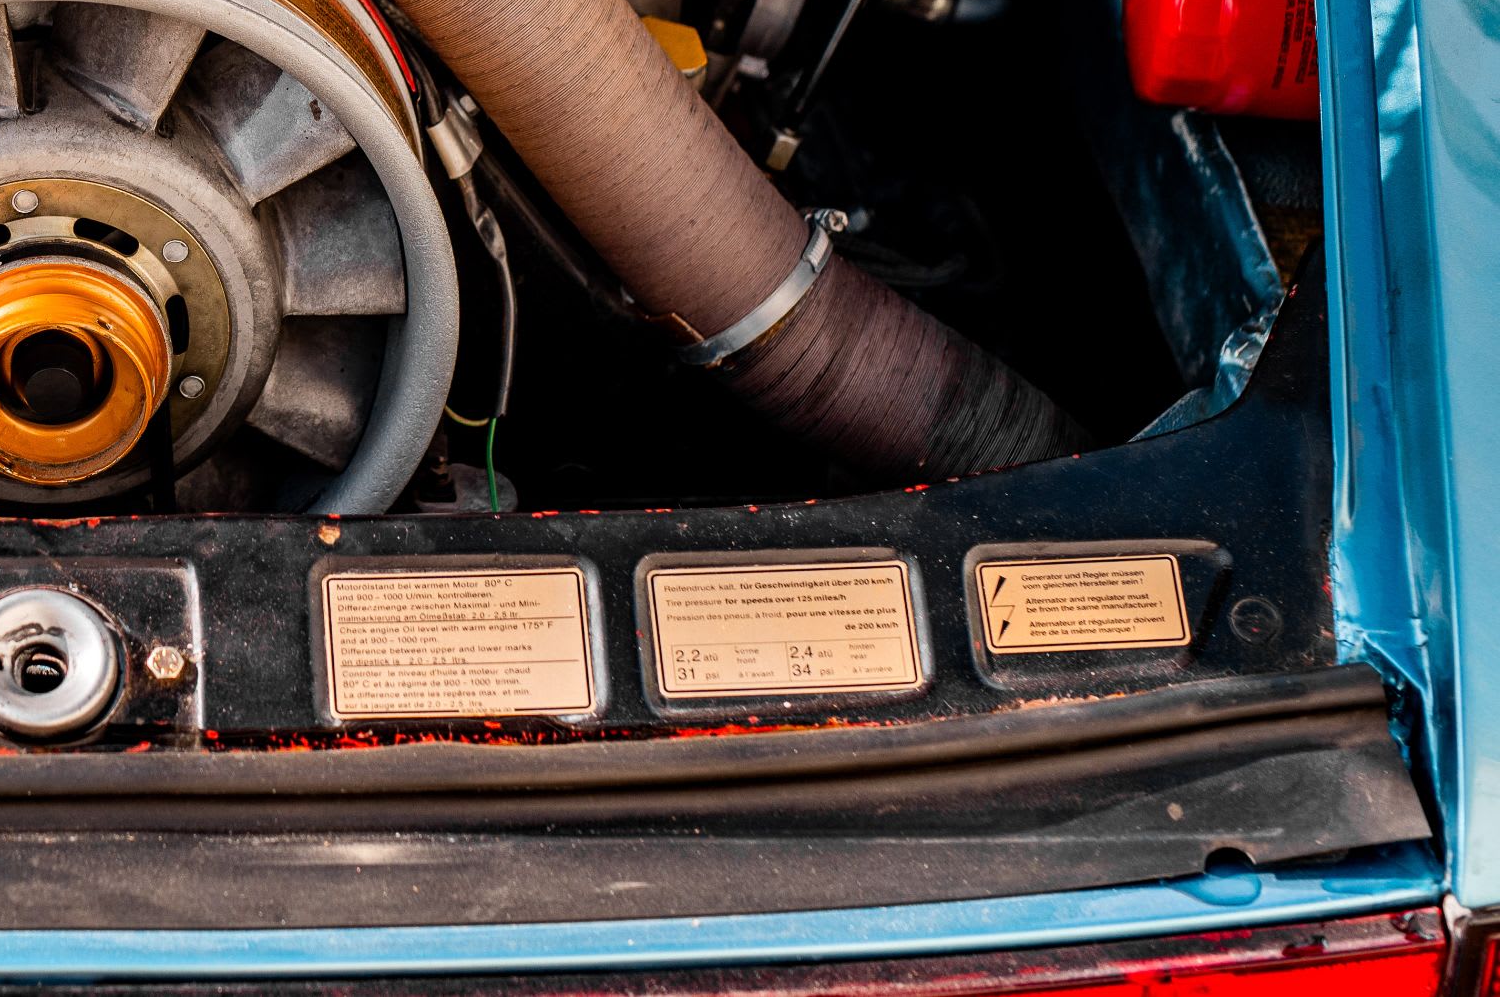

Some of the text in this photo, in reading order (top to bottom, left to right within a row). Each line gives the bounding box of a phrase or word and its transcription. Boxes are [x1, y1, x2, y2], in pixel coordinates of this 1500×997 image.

[1020, 573, 1062, 581] Generator
[1082, 570, 1108, 579] Regler
[1110, 569, 1145, 577] müssen
[452, 580, 477, 588] Motor
[504, 578, 512, 586] C
[663, 583, 715, 592] Reifendruck
[754, 579, 830, 590] Geschwindigkeit
[831, 578, 851, 586] über
[1041, 581, 1078, 590] gleichen
[740, 596, 773, 605] speeds
[1025, 596, 1067, 604] Alternator
[1087, 593, 1125, 603] regulator
[1101, 601, 1157, 609] manufacturer
[666, 613, 704, 621] Pression
[827, 608, 861, 616] vitesse
[875, 606, 897, 614] plus
[339, 626, 366, 634] Check
[488, 623, 518, 632] engine
[547, 620, 553, 628] F
[858, 622, 874, 630] 200
[875, 621, 899, 629] km/h
[1029, 619, 1075, 627] Alternateur
[1098, 626, 1131, 634] marque
[340, 646, 386, 655] Difference
[504, 643, 531, 651] marks
[789, 645, 813, 659] 2,4
[674, 649, 701, 663] 2,2
[355, 657, 388, 667] dipstick
[503, 666, 530, 674] chaud
[677, 667, 695, 680] 31
[791, 663, 811, 676] 34
[443, 678, 460, 686] 900
